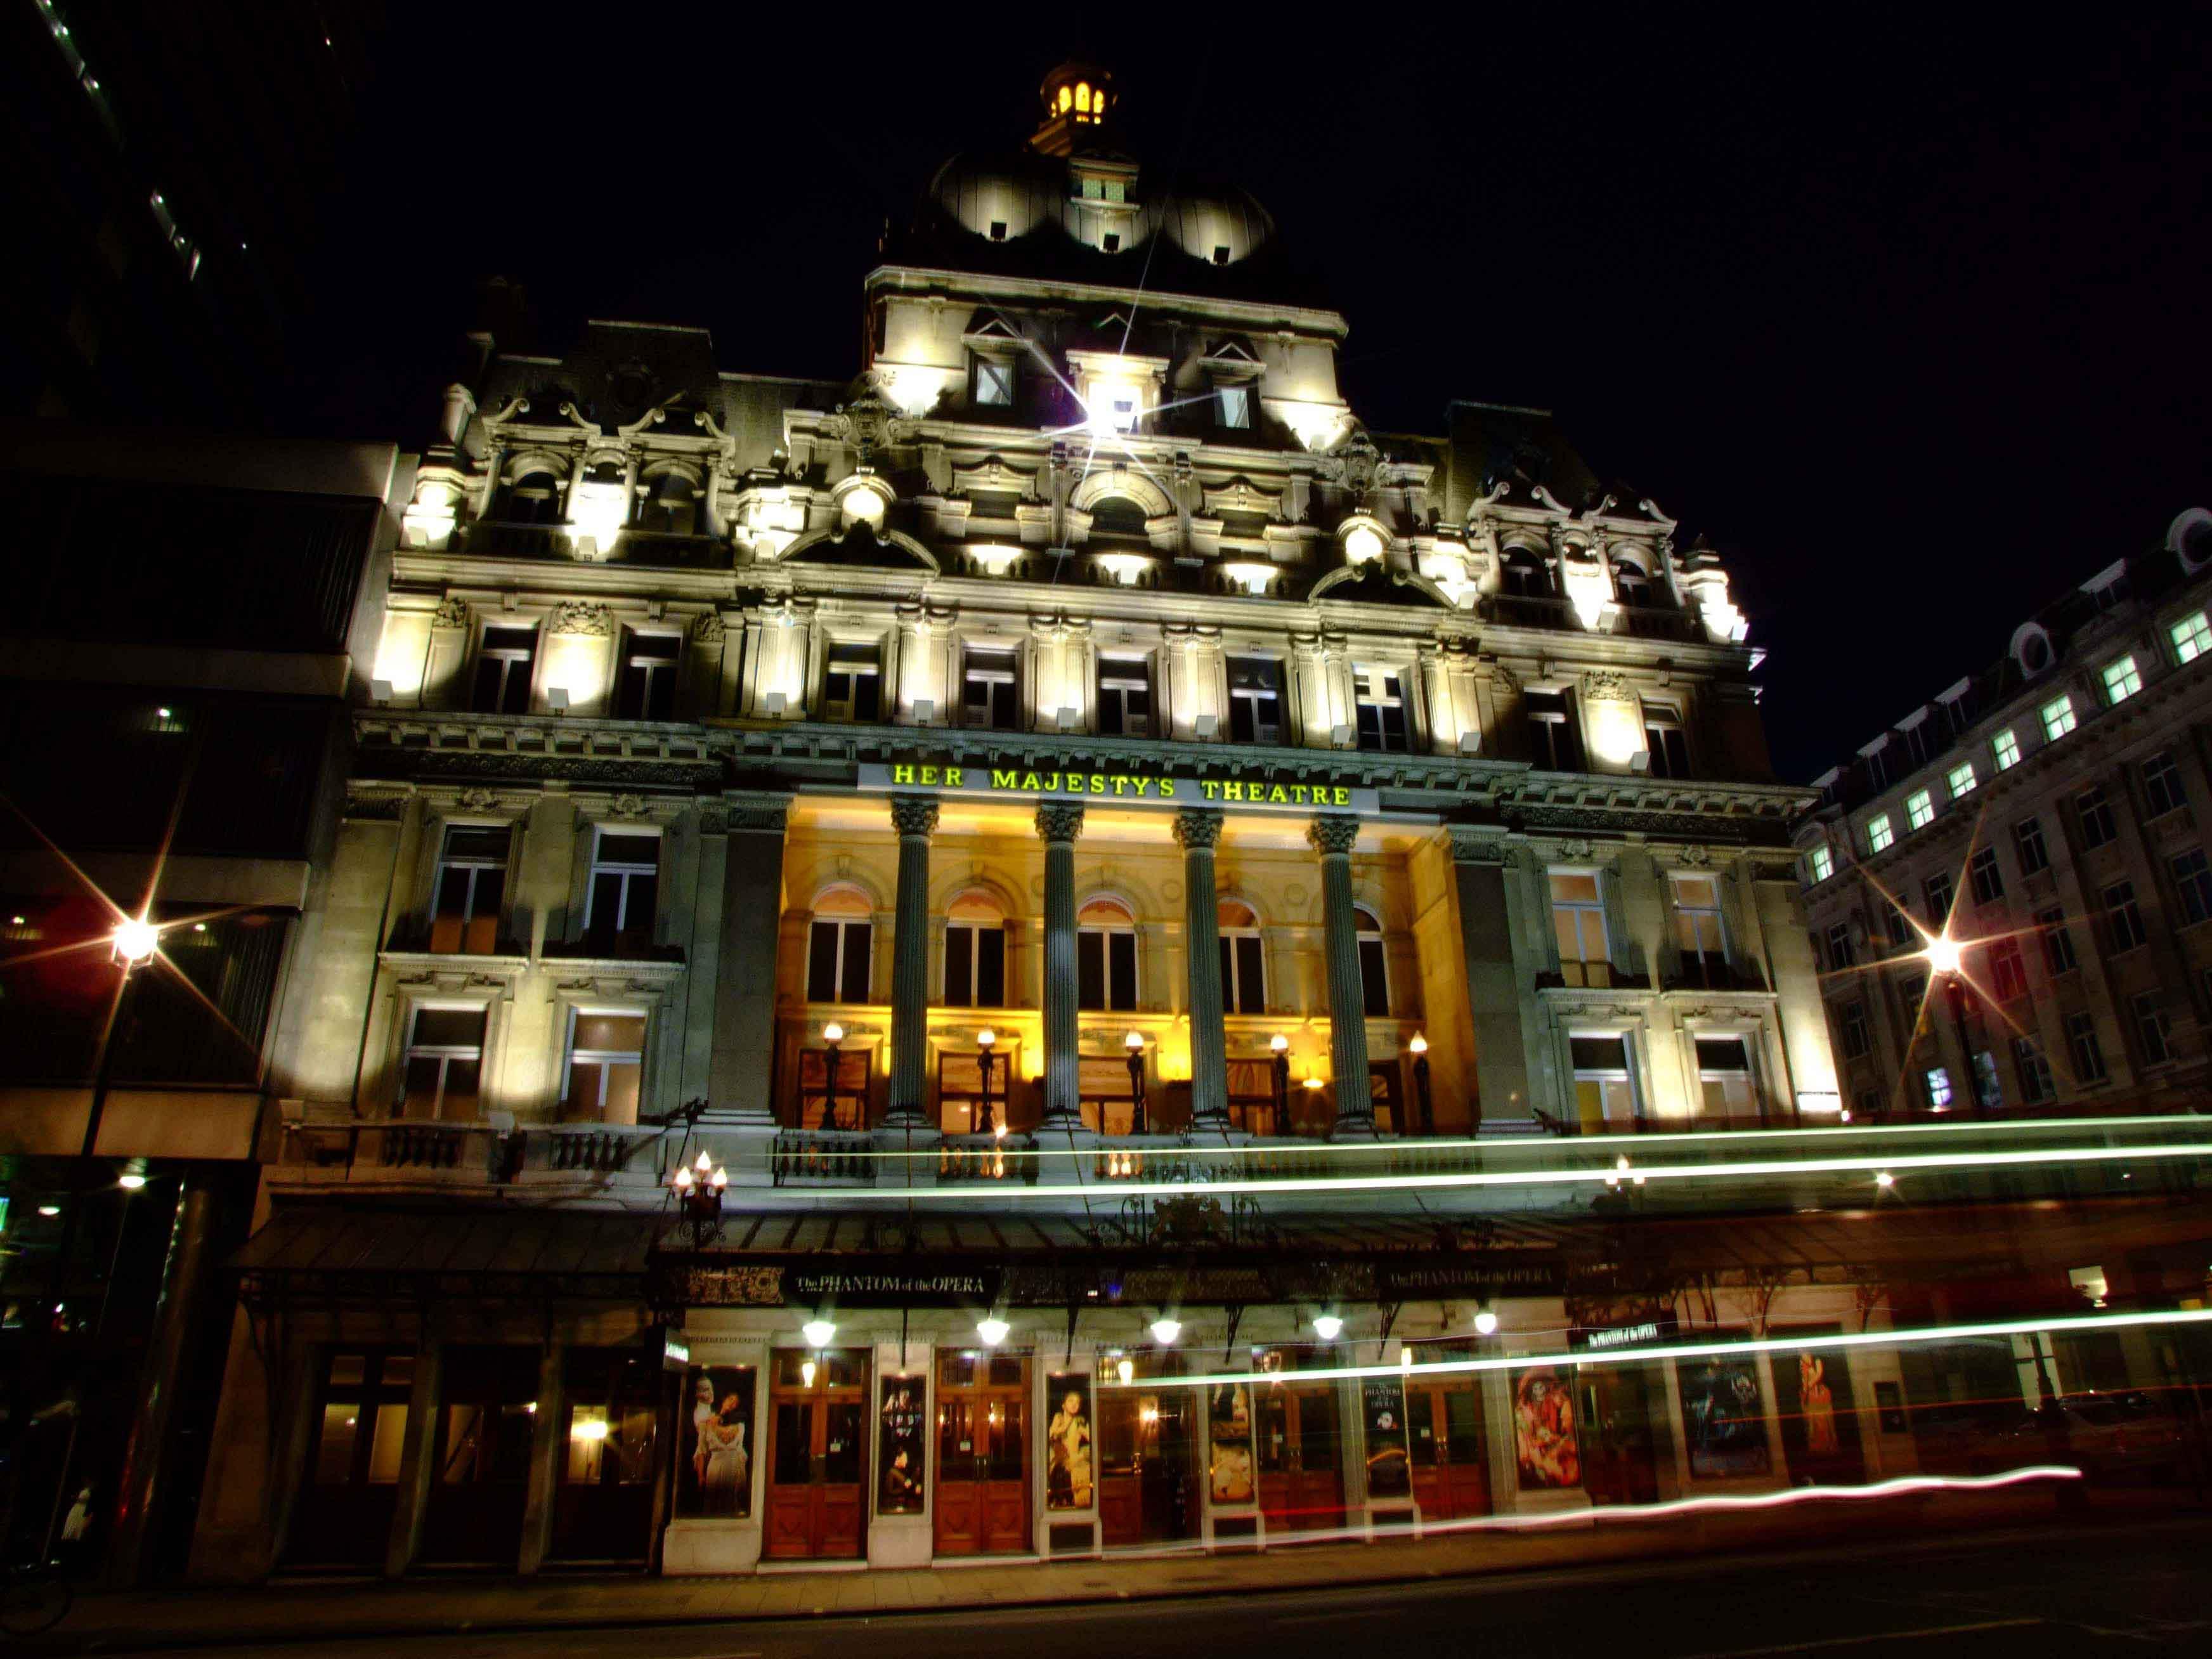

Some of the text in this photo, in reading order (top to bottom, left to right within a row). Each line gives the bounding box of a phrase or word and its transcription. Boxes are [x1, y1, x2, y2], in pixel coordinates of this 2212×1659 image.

[893, 764, 1351, 806] HER MAJESTY'S THEATRE
[820, 1274, 900, 1293] PHANTOM
[932, 1275, 985, 1293] OPERA
